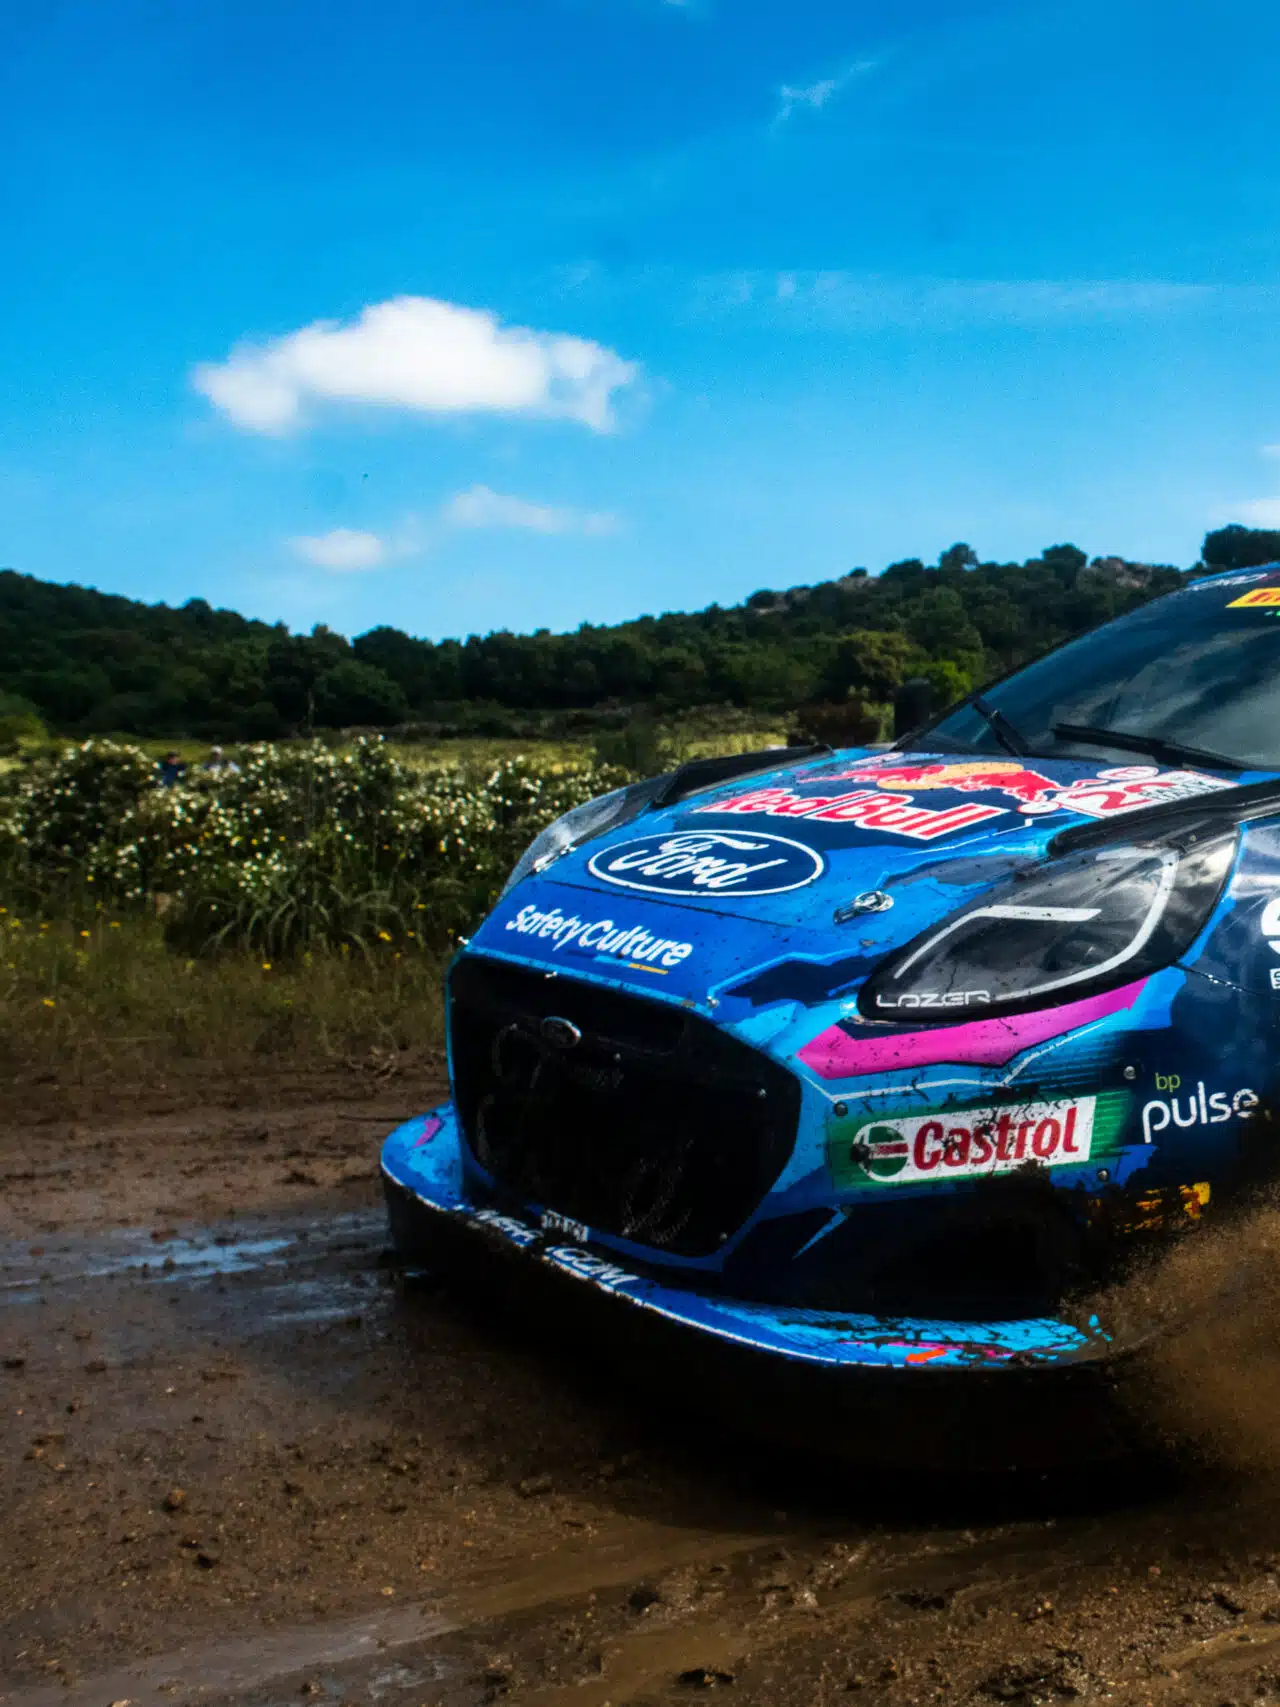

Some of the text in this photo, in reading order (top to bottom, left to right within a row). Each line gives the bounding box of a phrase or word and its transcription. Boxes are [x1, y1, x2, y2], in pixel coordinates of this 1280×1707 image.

[692, 787, 1012, 840] Red Bull
[608, 833, 788, 888] Ford
[876, 990, 991, 1008] LAZER
[1154, 1072, 1181, 1093] bp
[913, 1106, 1079, 1171] Castrol
[1142, 1081, 1259, 1144] pulse
